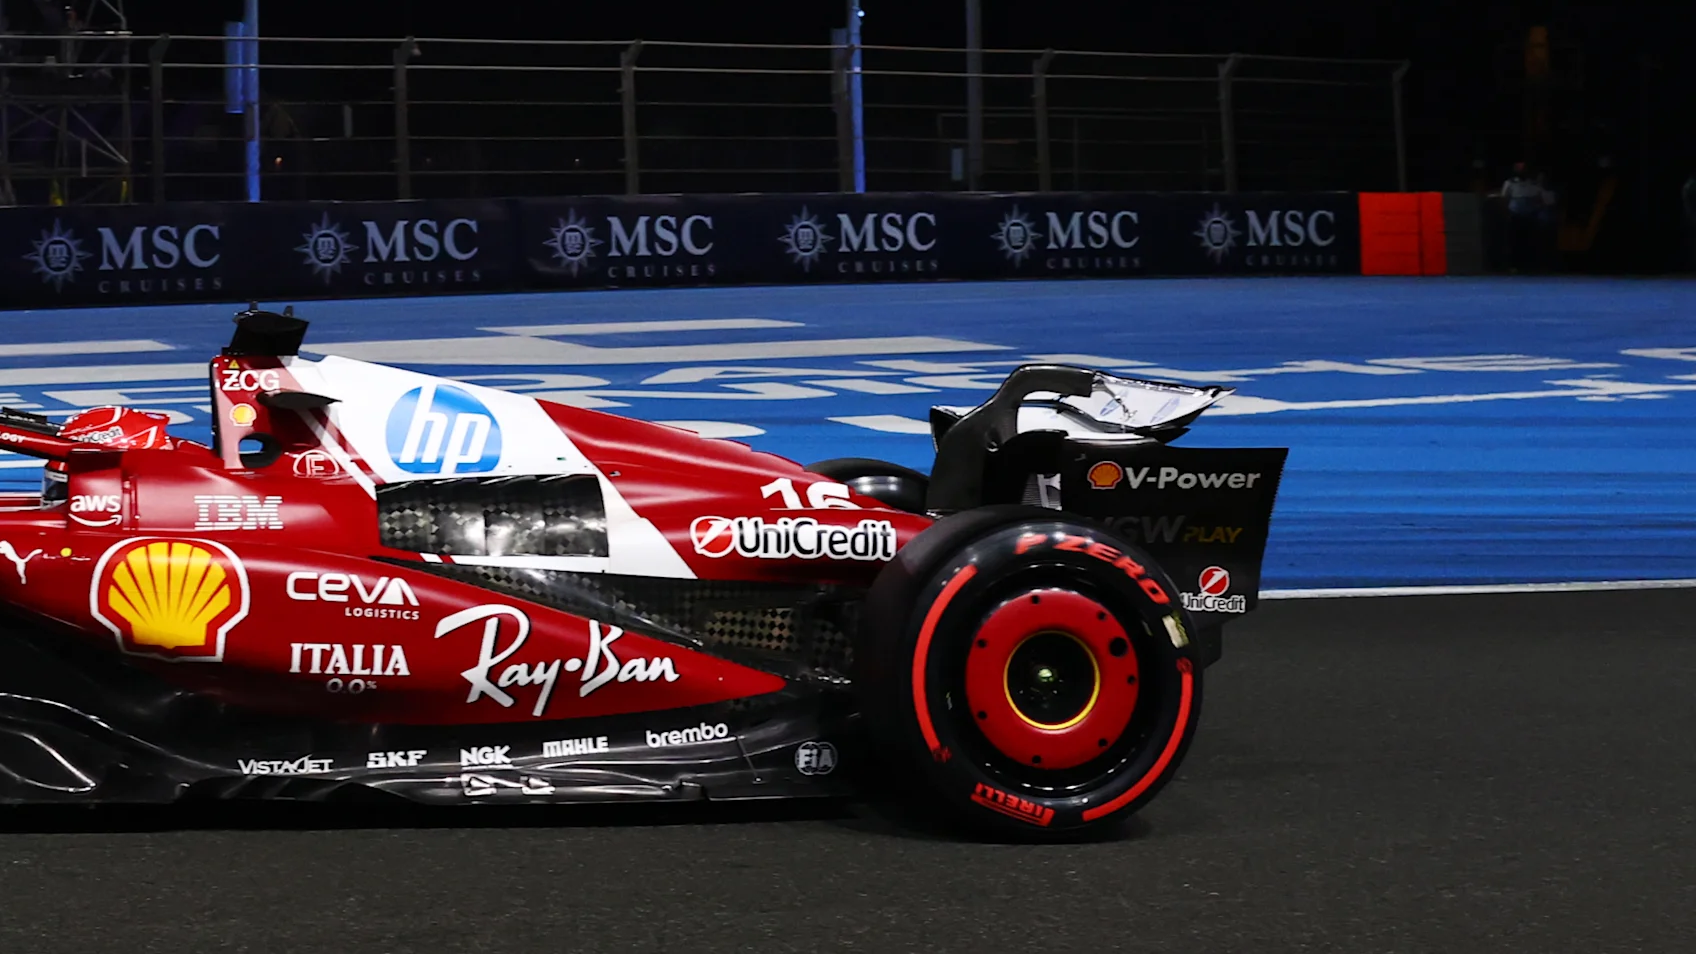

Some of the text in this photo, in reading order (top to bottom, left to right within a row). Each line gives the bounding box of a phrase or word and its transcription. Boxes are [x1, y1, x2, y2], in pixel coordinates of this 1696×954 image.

[362, 218, 479, 263] MSC
[607, 214, 714, 257] MSC
[836, 211, 936, 253] MSC
[1046, 210, 1139, 249] MSC
[1245, 209, 1336, 247] MSC
[97, 224, 220, 271] MSC
[98, 276, 222, 294] CRUISES
[364, 269, 481, 285] CRUISES
[396, 383, 494, 474] hp
[1124, 466, 1261, 490] V-Power
[70, 494, 121, 514] aws
[194, 495, 284, 530] IBM
[735, 518, 897, 561] UniCredit
[1183, 526, 1245, 544] PLAY
[1052, 532, 1171, 605] ZERO
[345, 607, 420, 621] LOGISTICS
[289, 643, 411, 677] ITALIA
[542, 736, 609, 758] MAHLE
[645, 722, 729, 748] brembo
[366, 750, 427, 769] SKF
[460, 744, 512, 766] NGK
[970, 782, 1057, 827] PIRELLI
